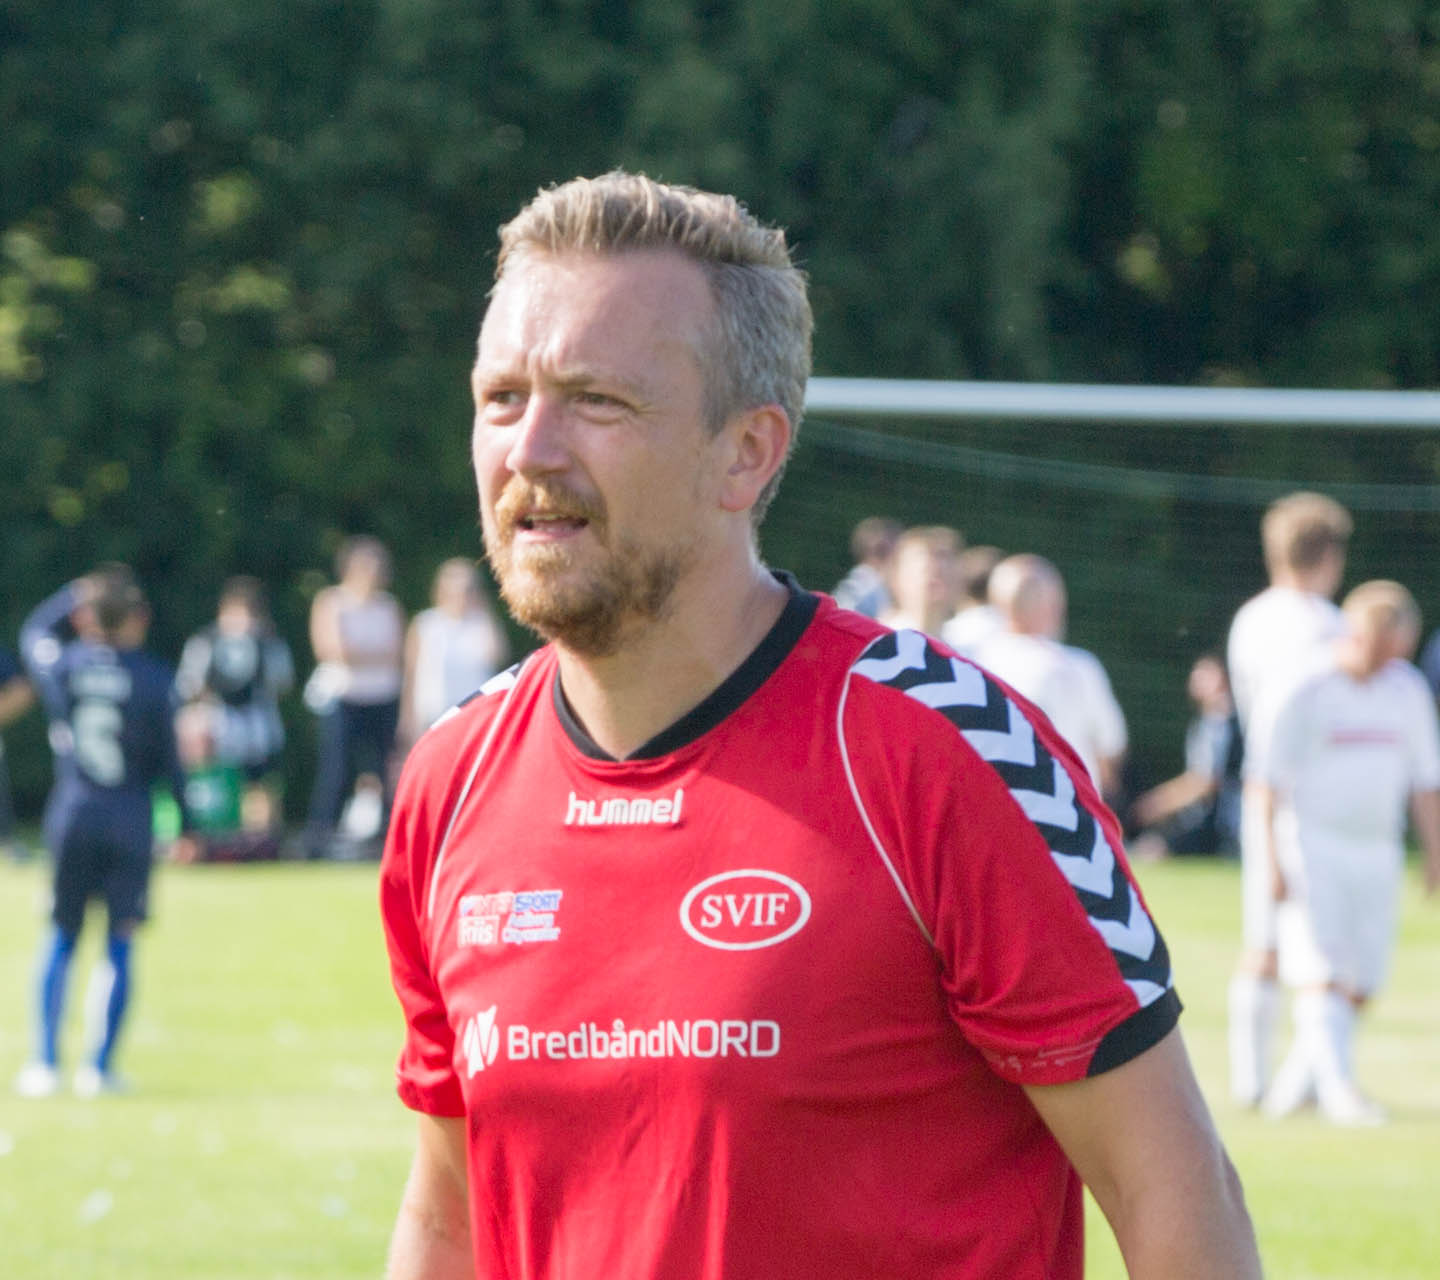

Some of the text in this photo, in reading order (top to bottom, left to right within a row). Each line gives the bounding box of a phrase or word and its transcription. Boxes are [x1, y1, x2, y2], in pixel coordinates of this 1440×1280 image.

[565, 788, 683, 826] hummel
[699, 892, 789, 928] SVIF
[507, 1018, 781, 1060] BredbåndNORD
